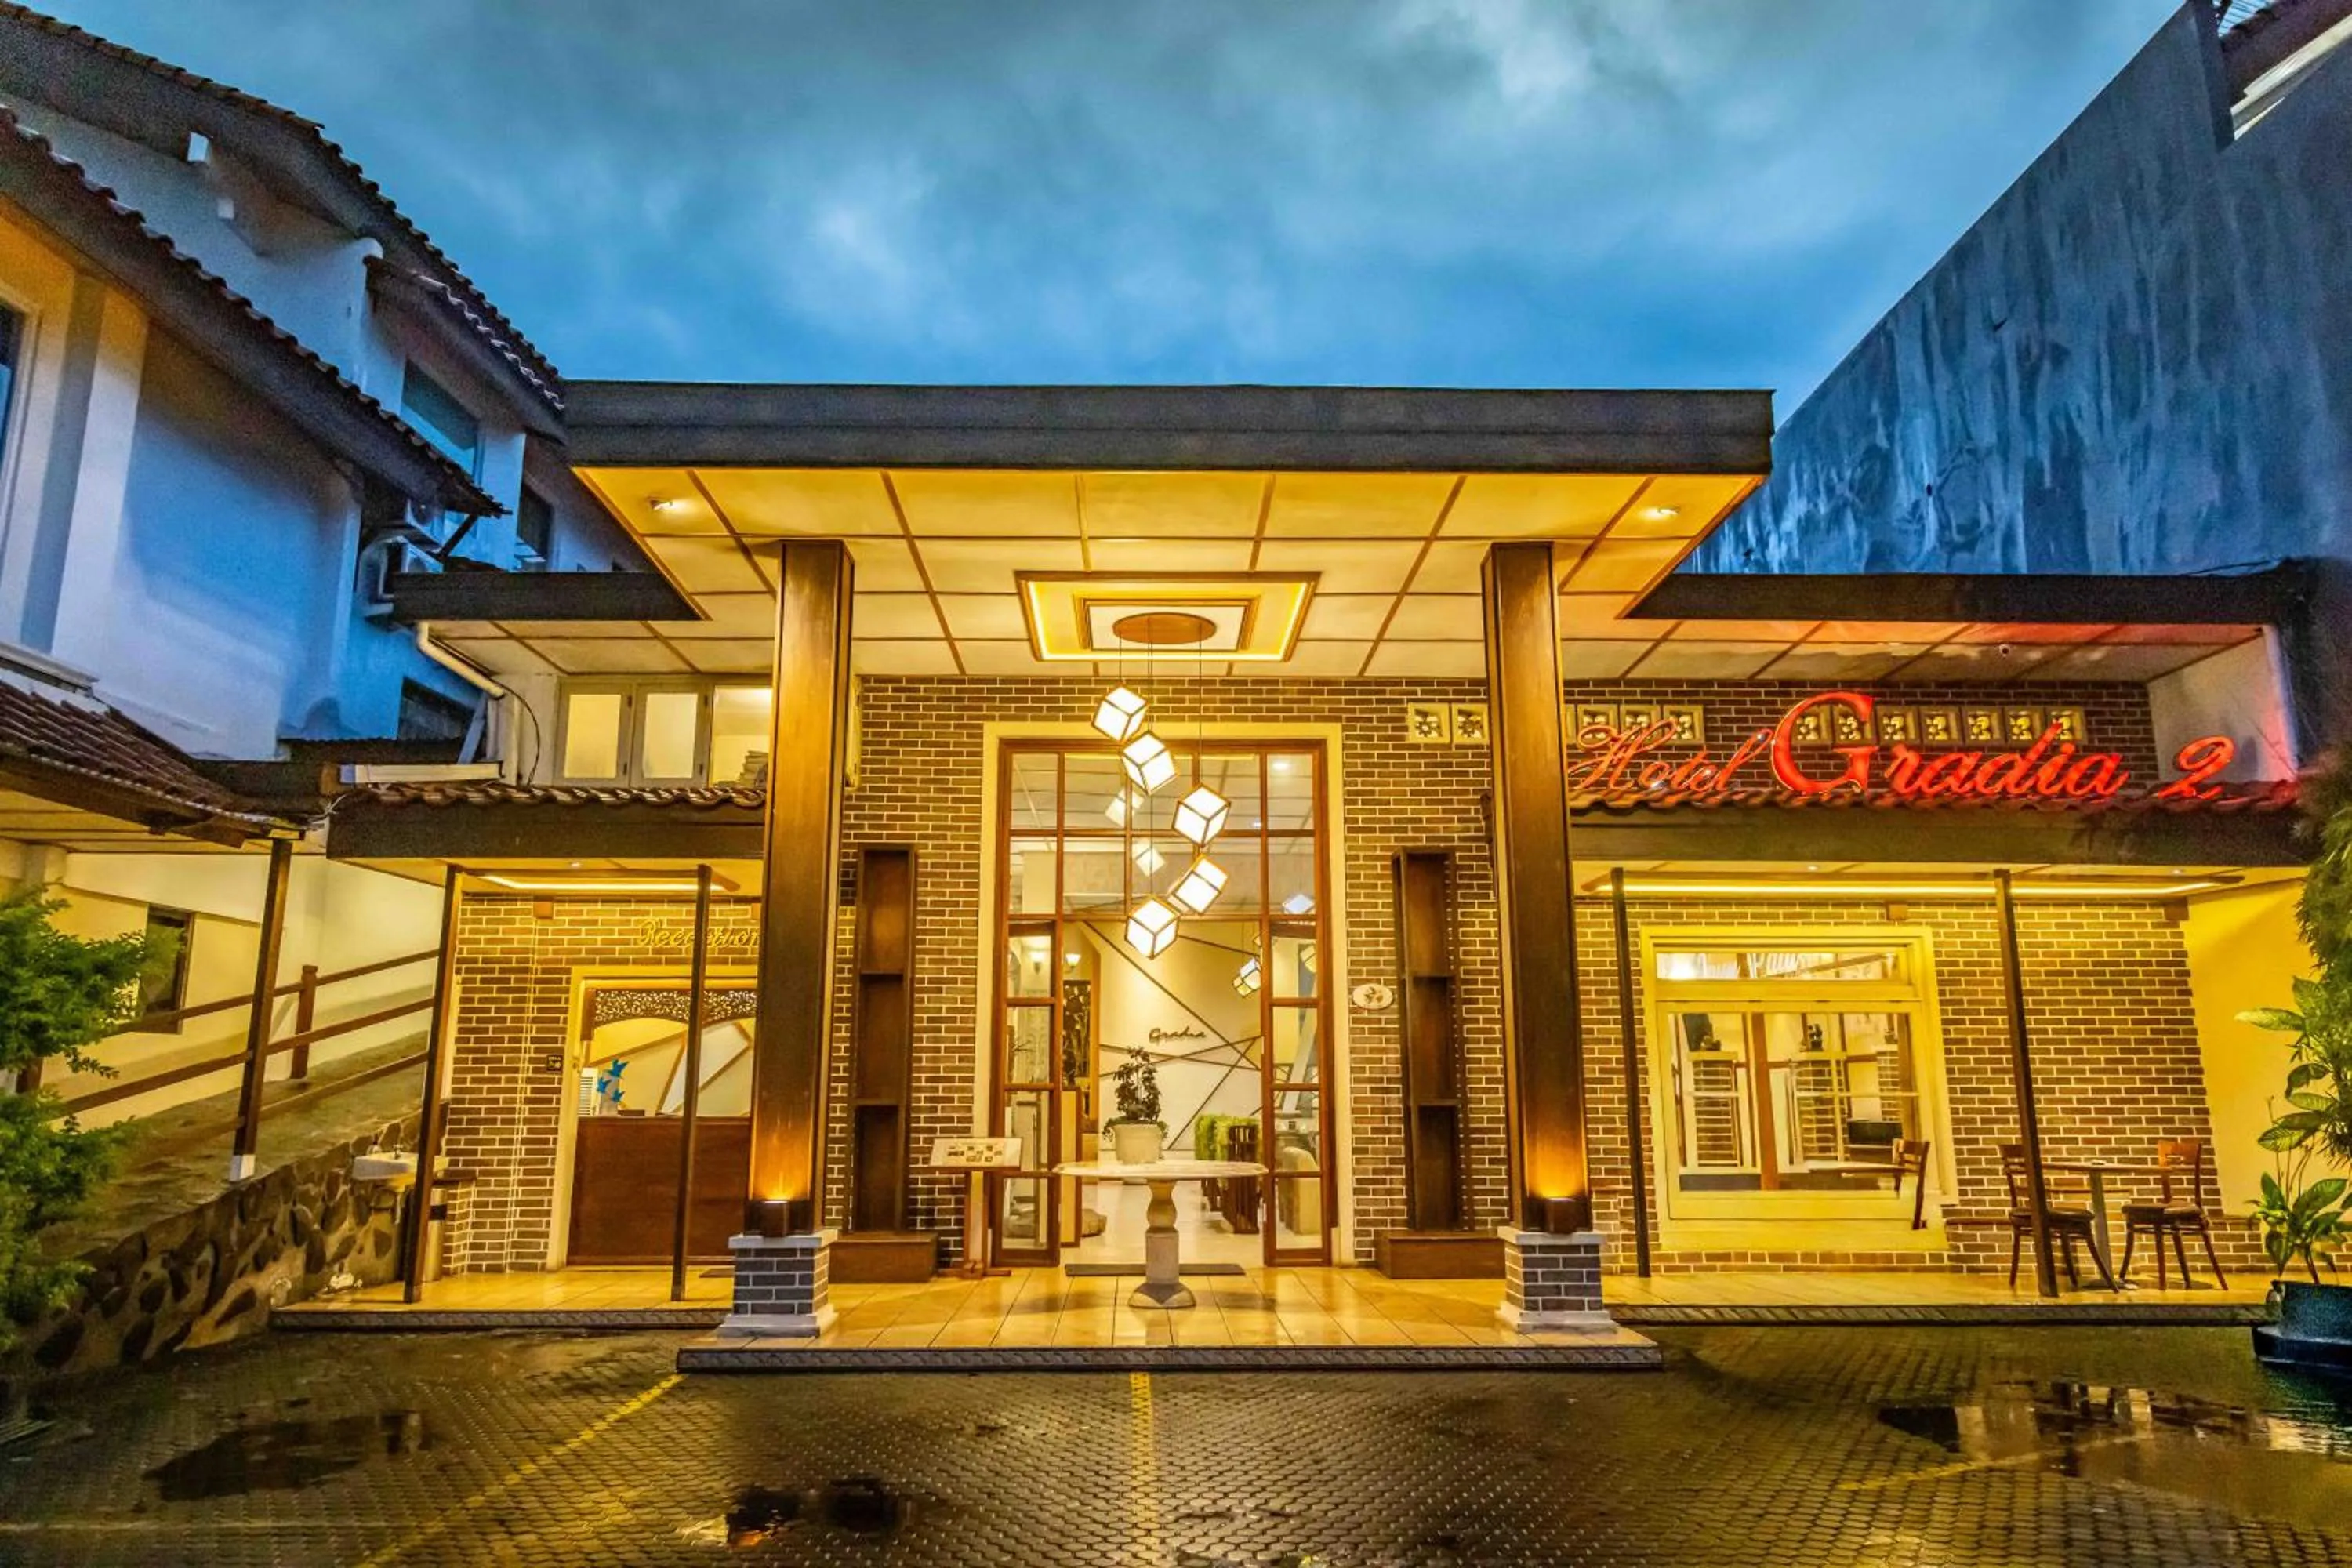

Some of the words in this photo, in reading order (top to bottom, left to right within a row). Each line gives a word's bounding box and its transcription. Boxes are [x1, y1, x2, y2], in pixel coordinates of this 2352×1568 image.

[1567, 718, 1772, 790] Hotel
[1771, 691, 2129, 796] Gradia
[2158, 735, 2235, 799] 2
